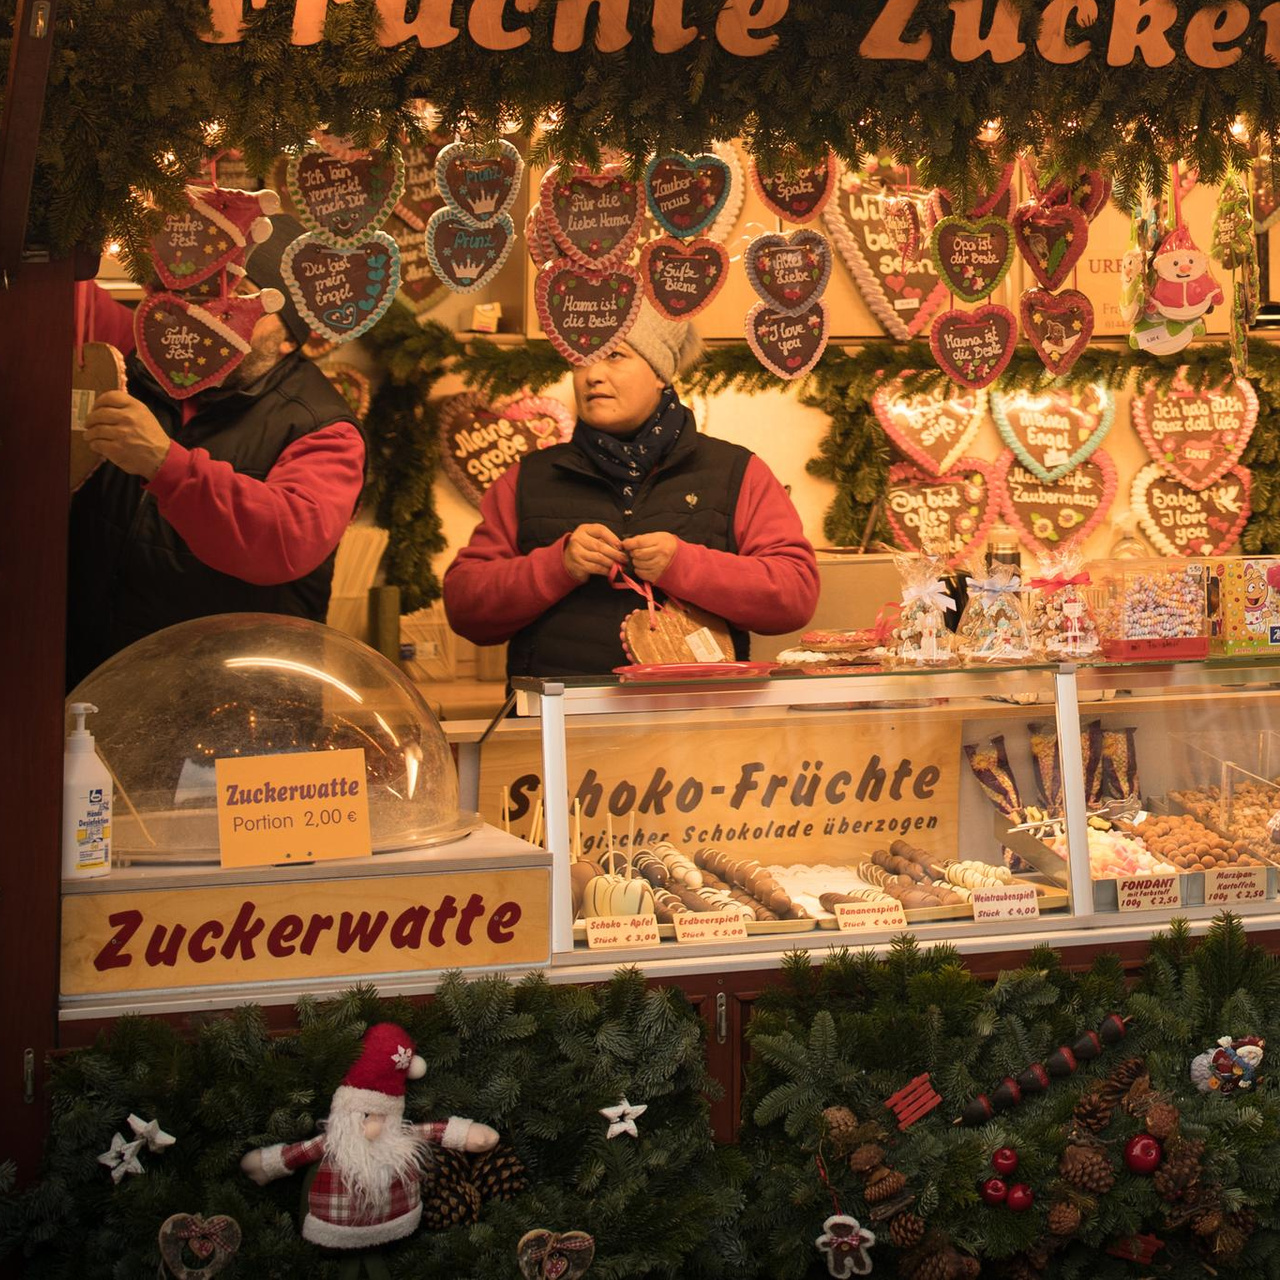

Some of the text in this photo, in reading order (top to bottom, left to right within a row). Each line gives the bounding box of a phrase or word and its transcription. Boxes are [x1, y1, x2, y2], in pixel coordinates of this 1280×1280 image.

[302, 171, 326, 187] Ich
[652, 177, 697, 198] Zauber-
[777, 180, 815, 201] Spatz
[572, 193, 621, 209] Für die
[659, 194, 691, 213] maus
[164, 214, 204, 233] Frohes
[567, 214, 632, 233] liebe Mama
[169, 232, 198, 248] Fest
[953, 236, 993, 252] Opa ist
[302, 256, 351, 277] Du bist
[970, 252, 1000, 265] Beste
[663, 260, 700, 281] Süße
[776, 269, 811, 285] Liebe
[314, 272, 346, 292] mein
[664, 278, 698, 295] Biene
[315, 288, 354, 308] Engel
[562, 294, 618, 312] Mama ist
[563, 314, 618, 328] die Beste
[161, 326, 200, 345] Frohes
[780, 322, 806, 339] love
[945, 328, 999, 350] Mama ist
[165, 342, 195, 360] Fest
[780, 338, 803, 356] you
[952, 343, 1003, 360] die Beste
[1180, 400, 1208, 417] hab
[1151, 415, 1240, 441] ganz lieb
[454, 417, 515, 458] Meine
[1026, 429, 1072, 456] Engel
[889, 490, 924, 513] Du
[1013, 486, 1100, 509] Zaubermaus
[904, 508, 951, 528] alles
[1174, 508, 1208, 526] love
[1174, 525, 1209, 545] you
[225, 776, 360, 807] Zuckerwatte
[502, 753, 941, 823] Shoko-Früchte
[233, 808, 358, 833] Portion 2,00 €
[823, 811, 939, 839] überzogen
[683, 818, 814, 847] Schokolade
[1120, 877, 1176, 891] FONDANT
[1216, 870, 1257, 880] Marzipan-
[1138, 888, 1171, 898] Farbstoff
[1216, 880, 1257, 891] Kartoffeln
[973, 889, 1035, 903] Weintraubenspieß
[1120, 895, 1179, 909] 100g 2,50
[1208, 889, 1265, 902] 100g 2,50
[839, 904, 900, 916] Bananenspieß
[977, 906, 1036, 918] Stück 4,00
[590, 920, 621, 930] Schoko
[678, 914, 740, 928] Erdbeerspieß
[93, 893, 523, 972] Zuckerwatte
[635, 933, 657, 942] 3,00
